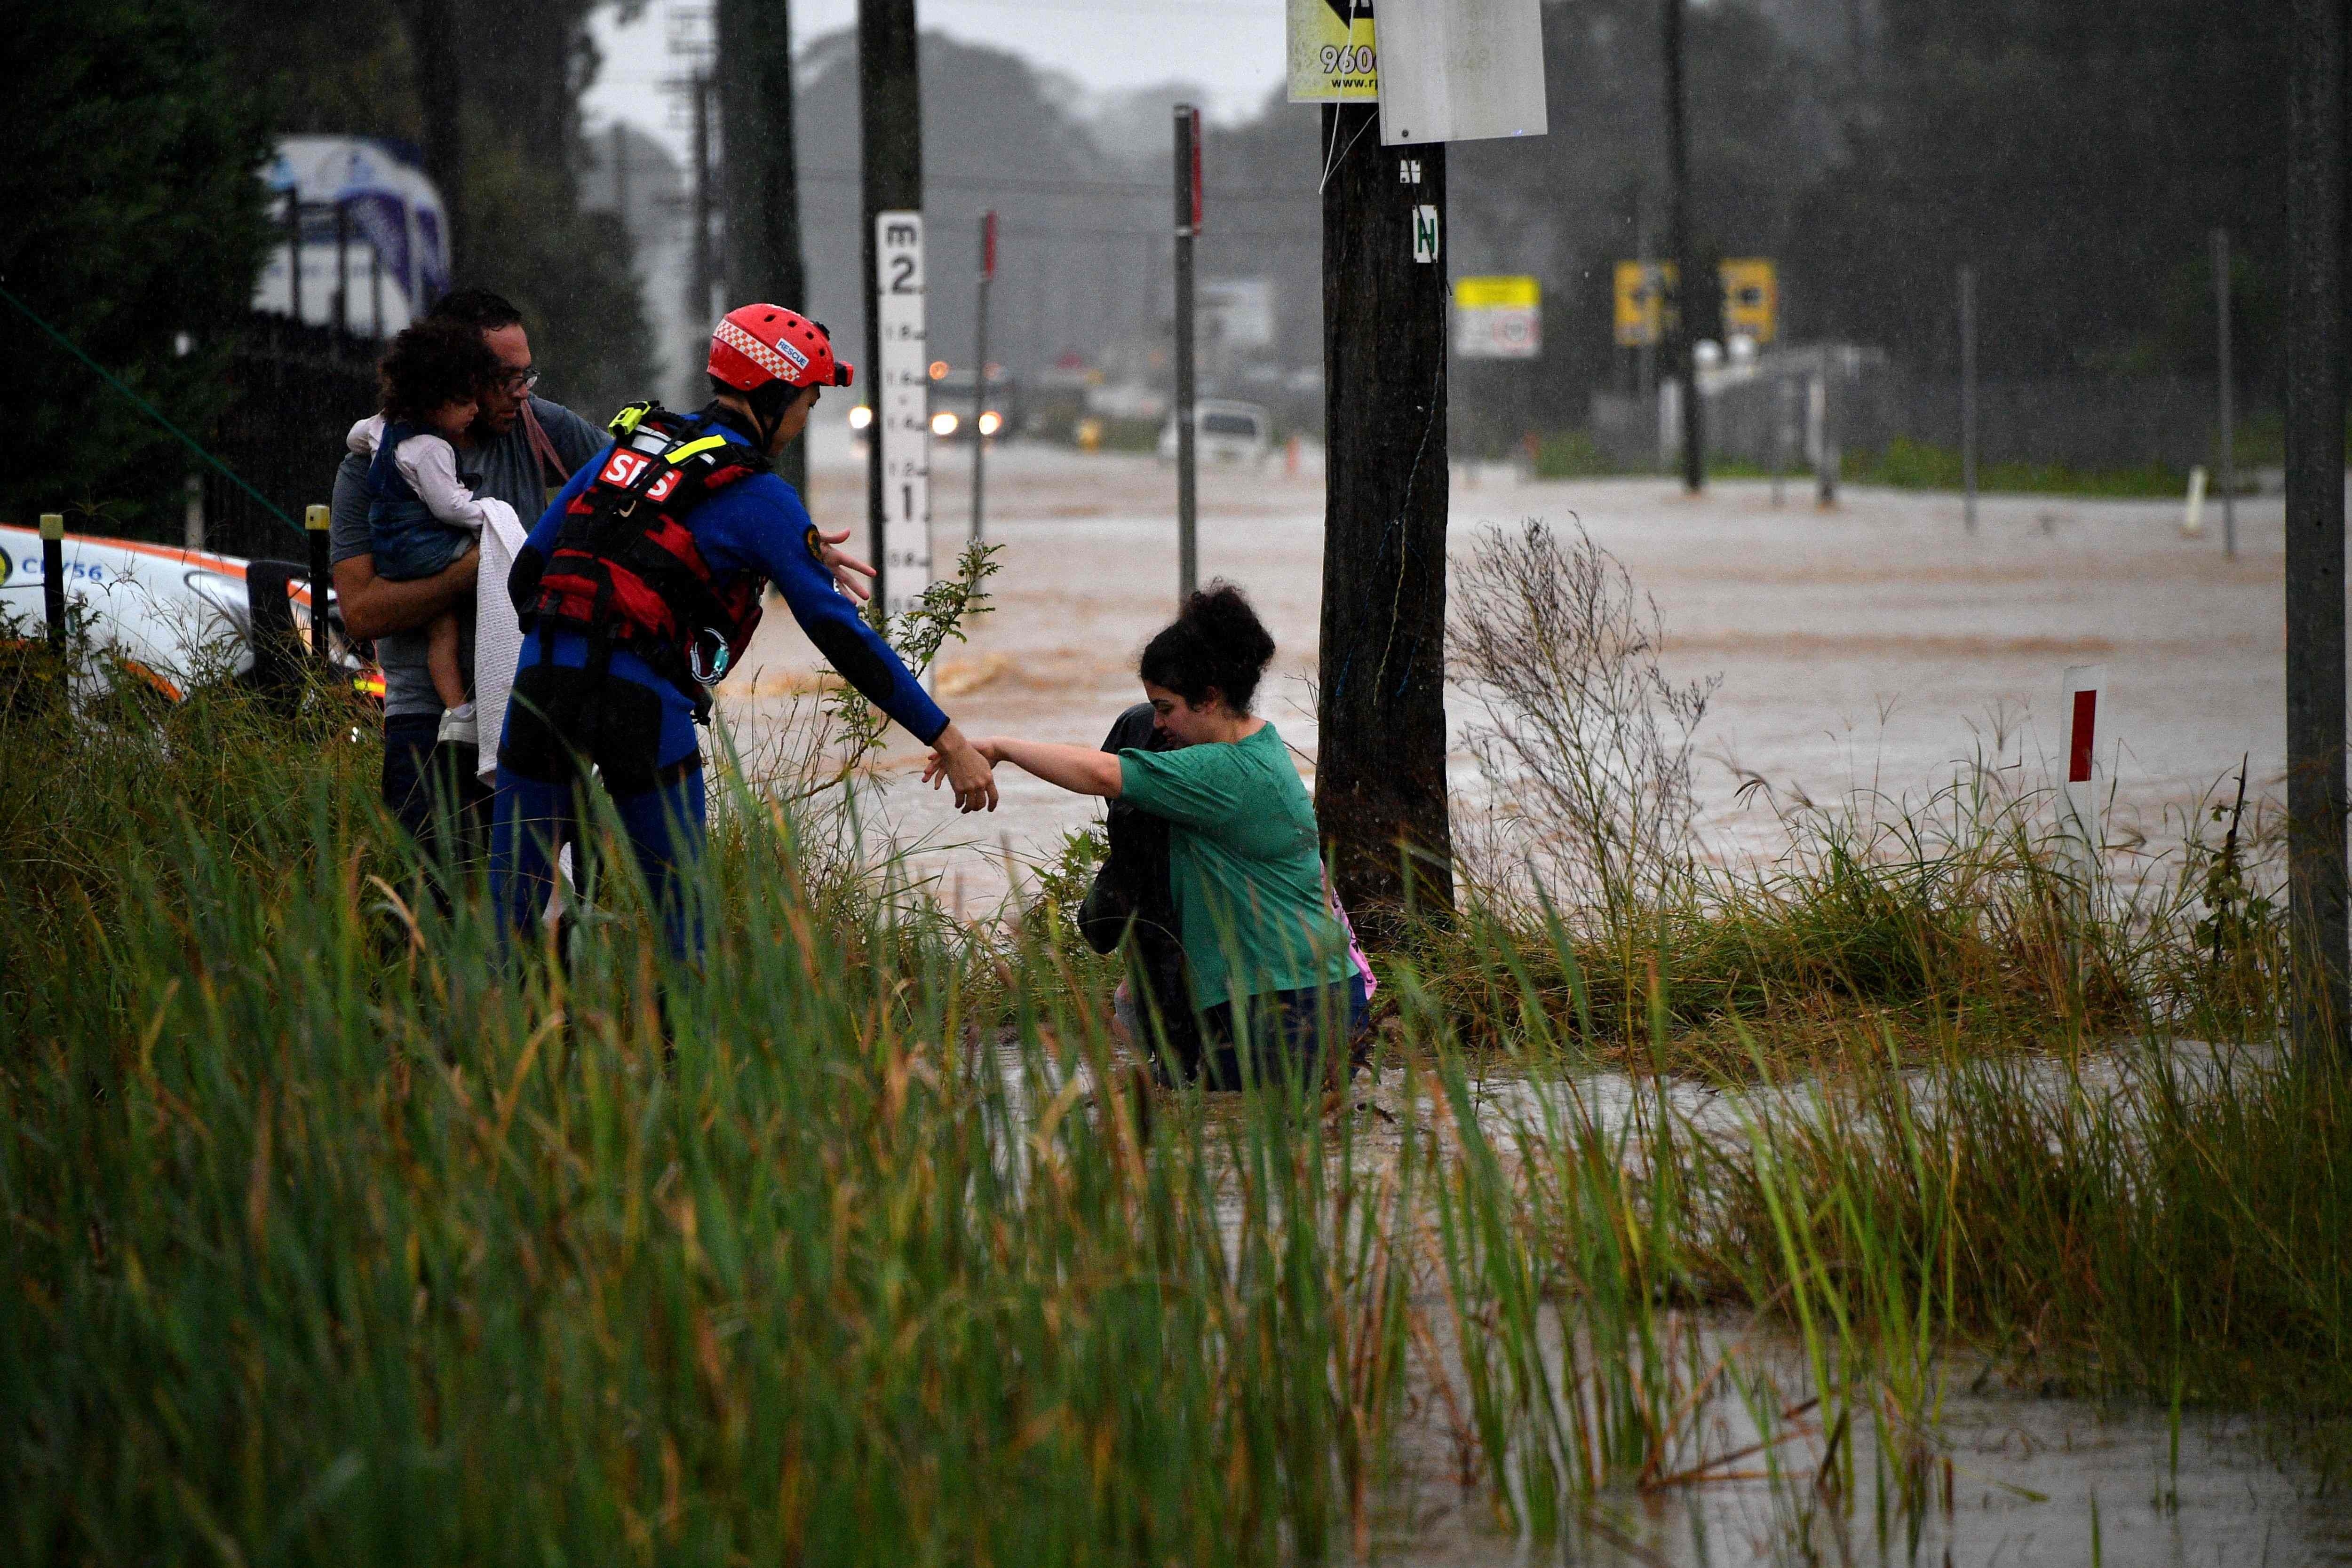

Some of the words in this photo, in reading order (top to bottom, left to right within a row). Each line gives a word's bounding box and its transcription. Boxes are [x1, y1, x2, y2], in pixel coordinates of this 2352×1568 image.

[1320, 45, 1377, 74] 960
[892, 256, 914, 294] 2
[778, 341, 807, 366] RESCUE
[903, 484, 912, 521] 1
[22, 558, 102, 581] C56
